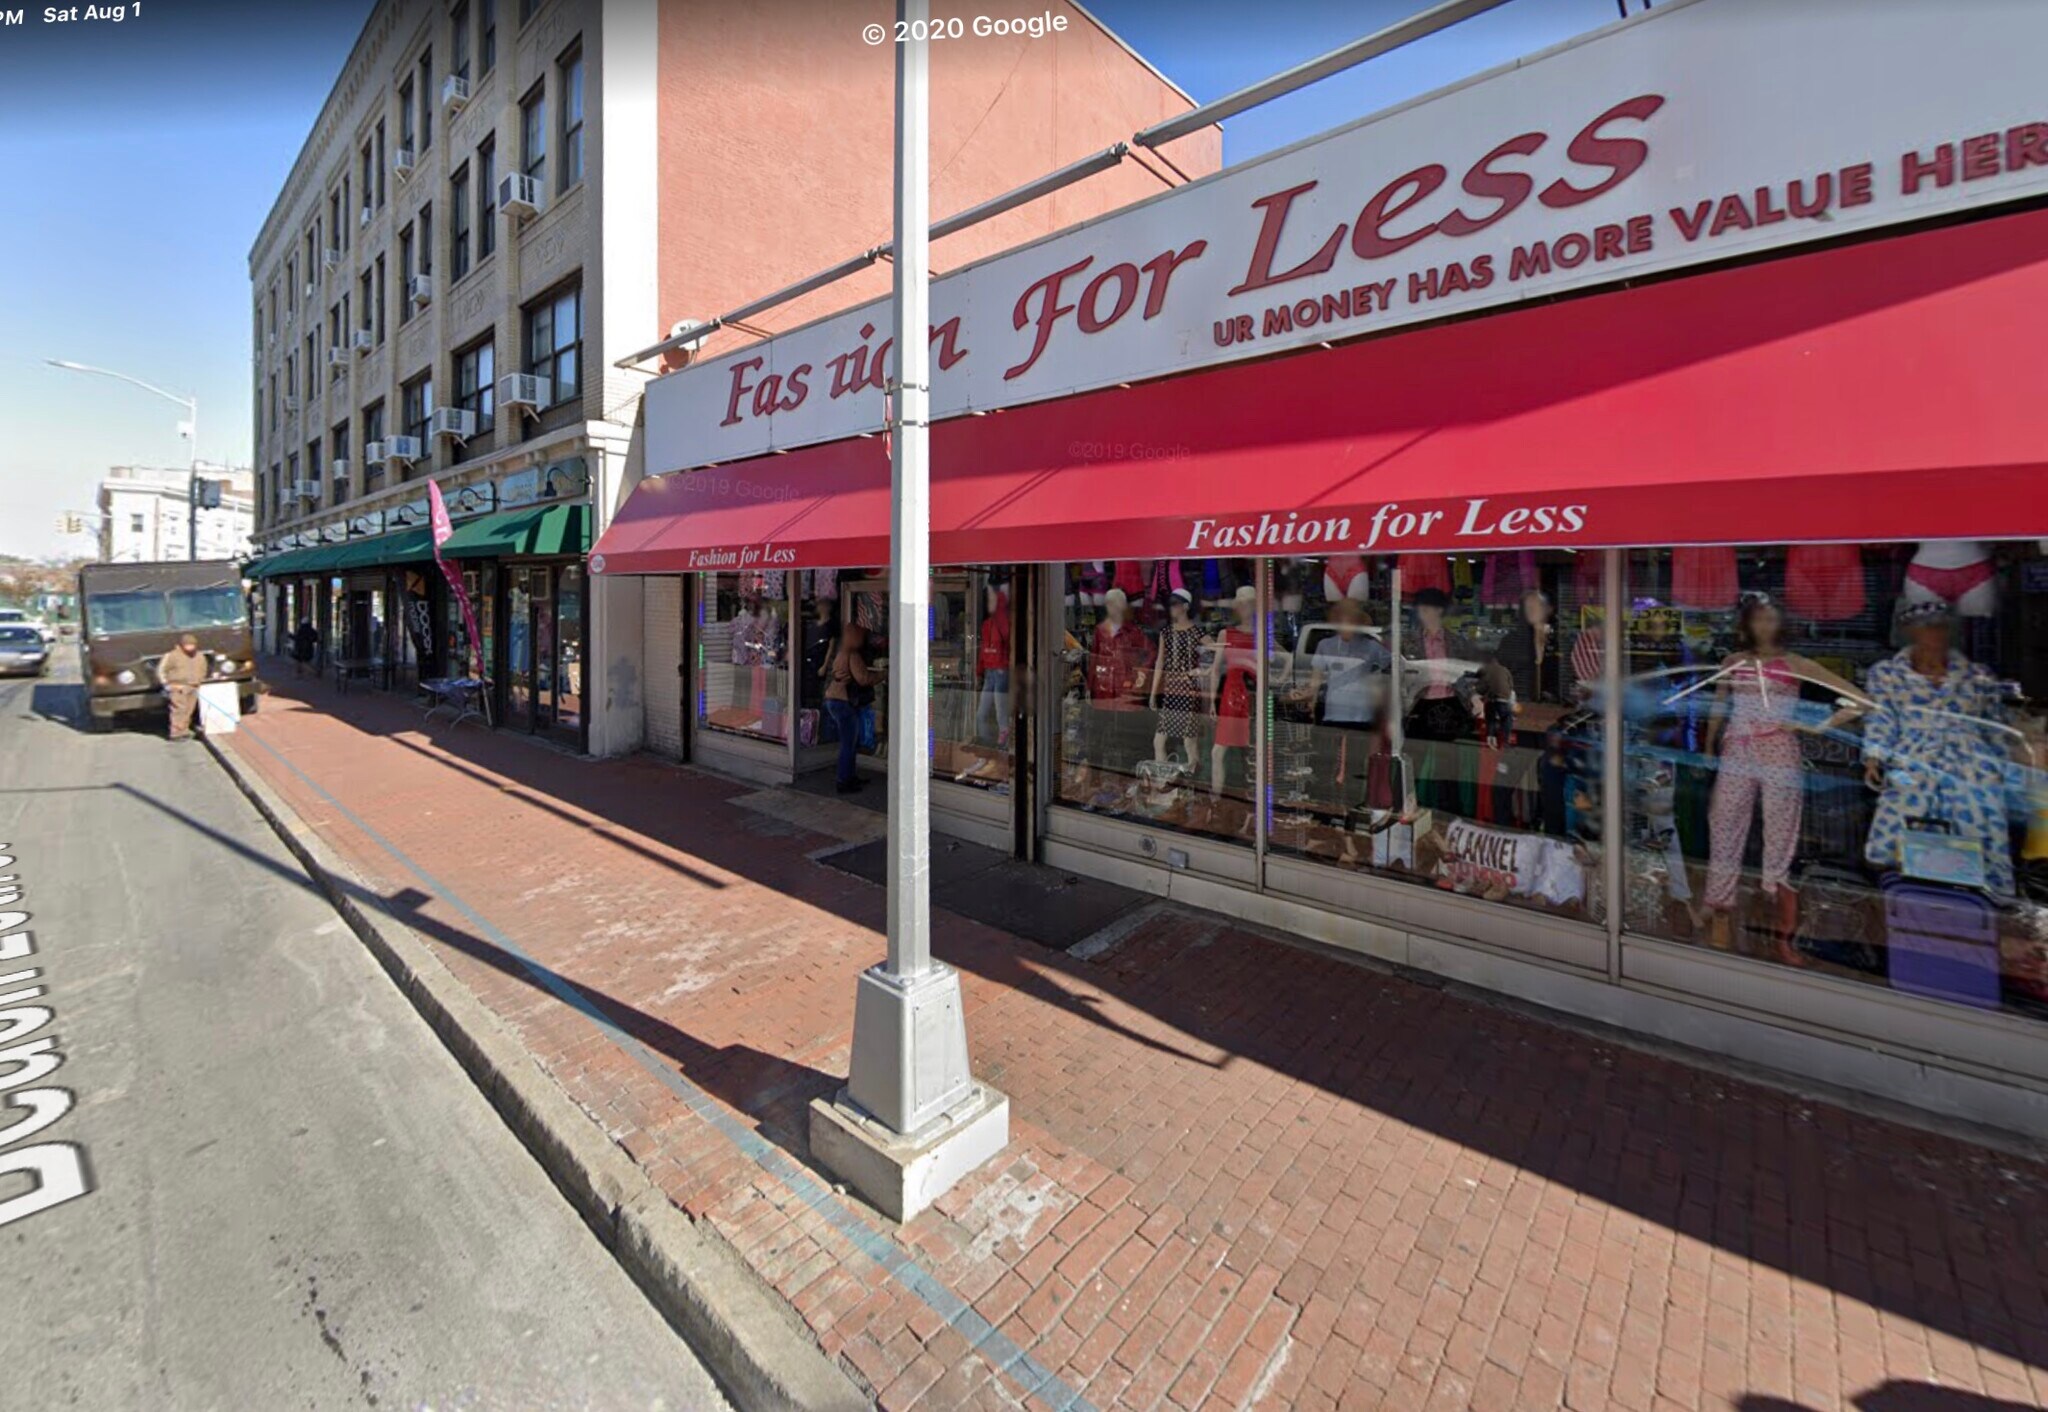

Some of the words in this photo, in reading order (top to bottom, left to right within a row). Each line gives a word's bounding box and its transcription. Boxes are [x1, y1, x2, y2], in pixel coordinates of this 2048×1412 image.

[1003, 239, 1207, 381] For
[1227, 94, 1666, 297] Less
[1213, 313, 1255, 348] UR
[1262, 278, 1398, 338] MONEY
[1408, 254, 1494, 304] HAS
[1508, 213, 1655, 282] MORE
[1669, 161, 1873, 242] VALUE
[688, 548, 737, 568] Fashion
[738, 545, 761, 569] for
[763, 543, 796, 563] Less
[1186, 512, 1352, 550] Fashion
[1358, 503, 1444, 549] for
[1455, 499, 1588, 537] Less
